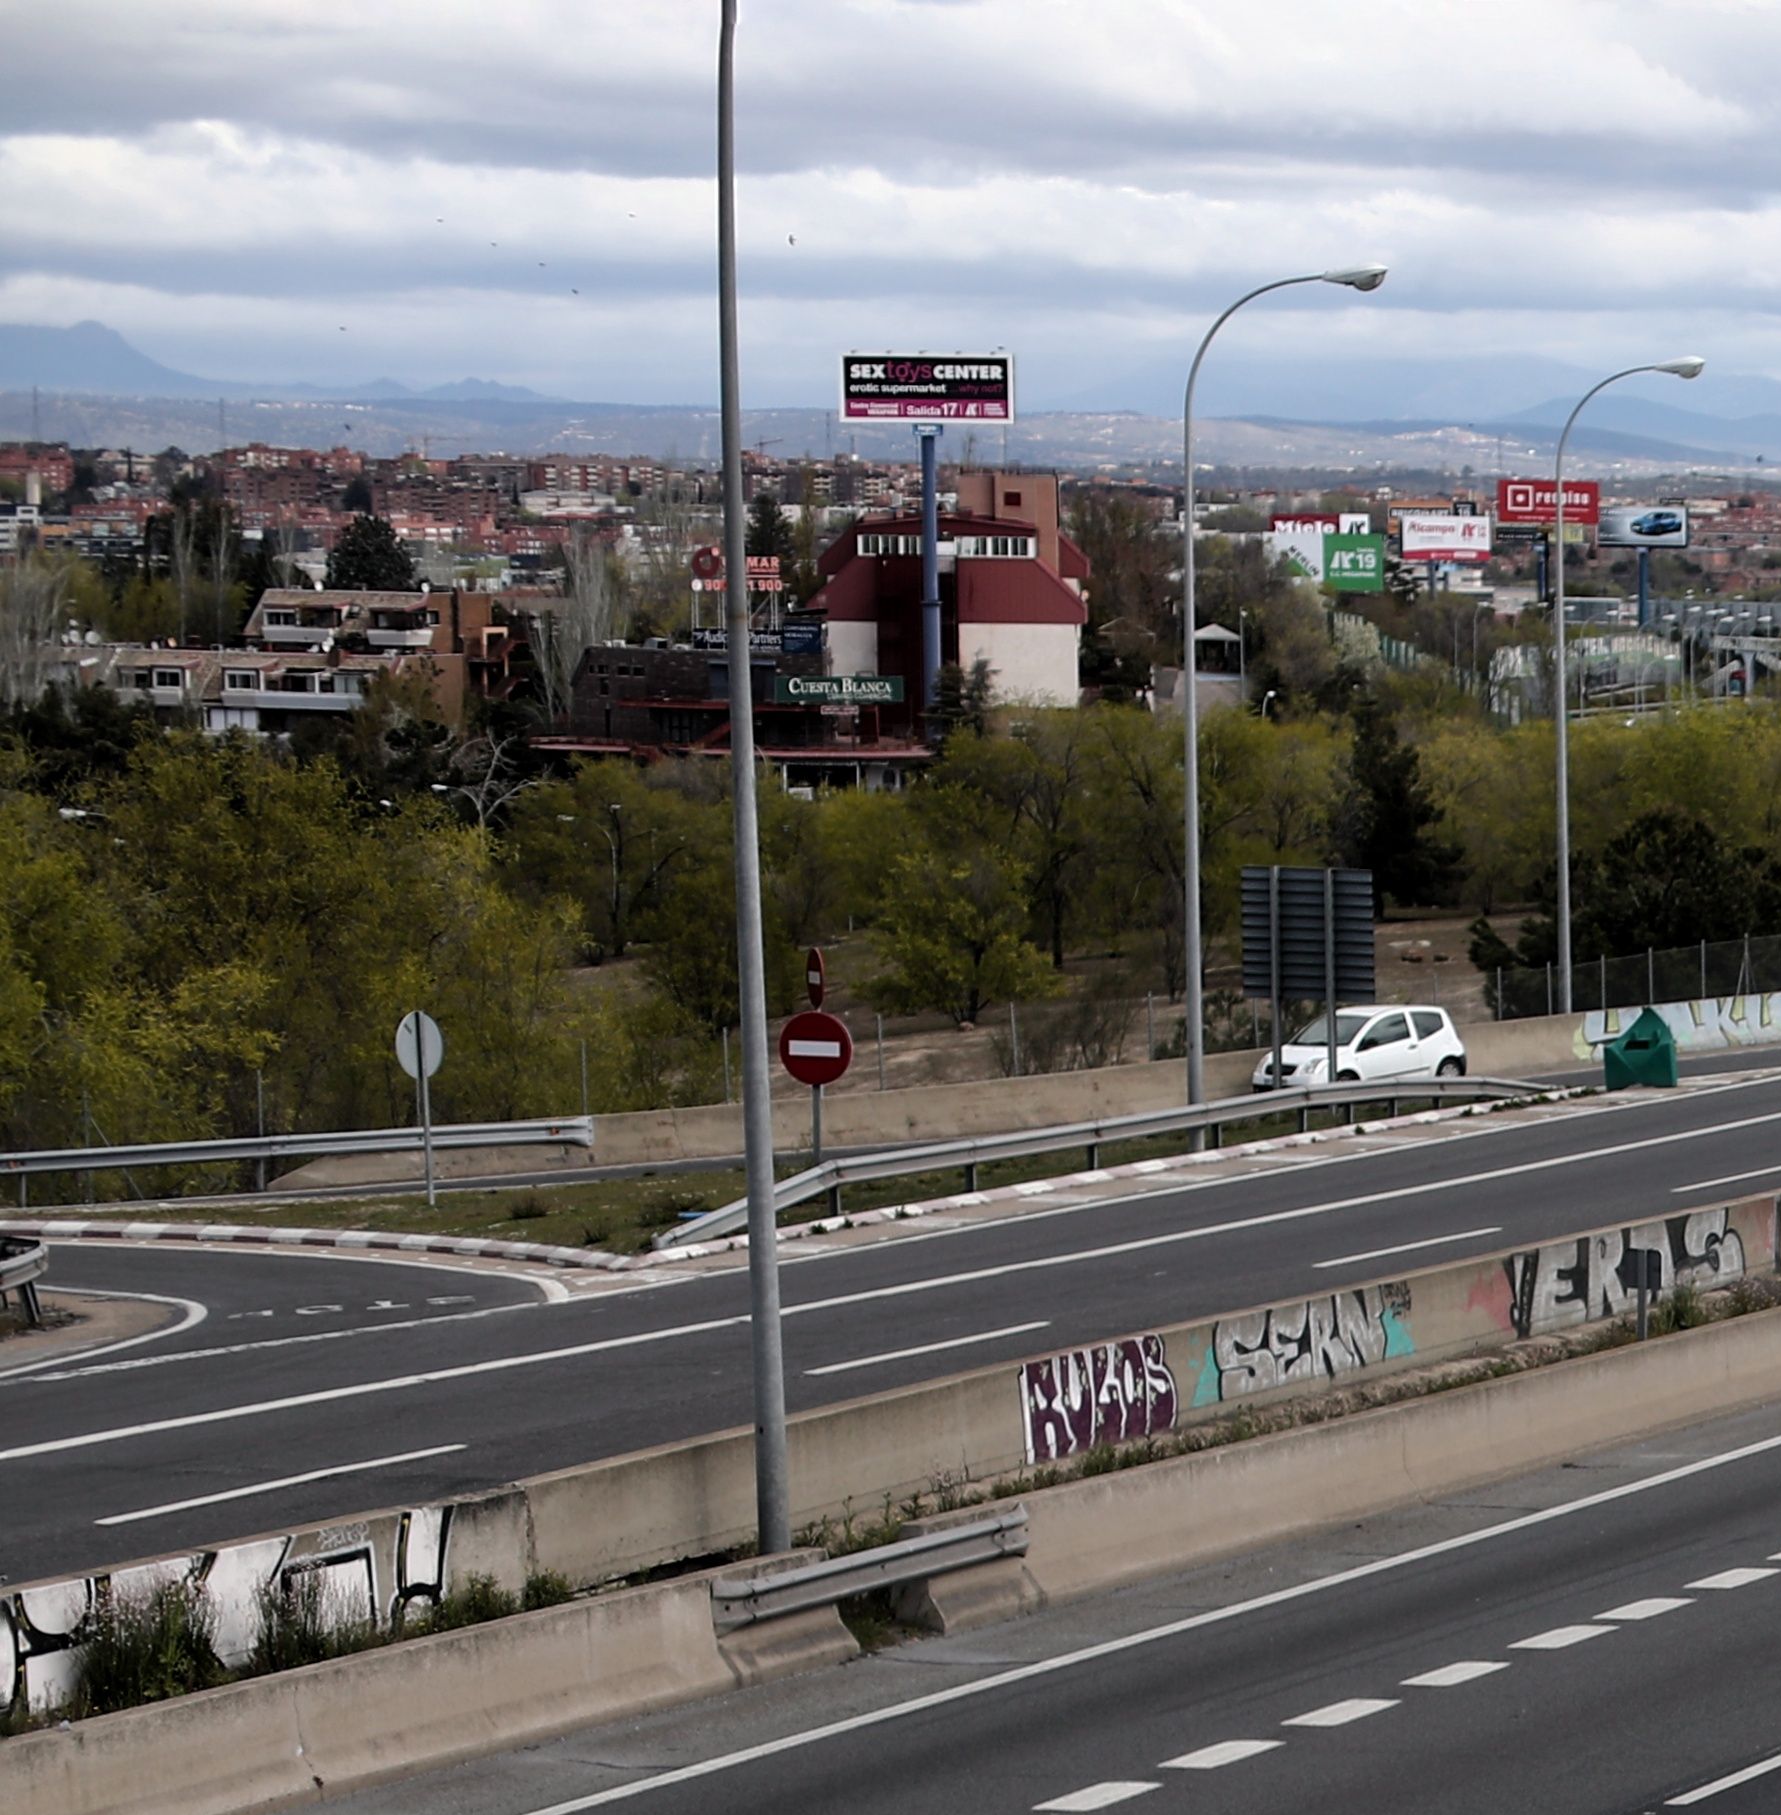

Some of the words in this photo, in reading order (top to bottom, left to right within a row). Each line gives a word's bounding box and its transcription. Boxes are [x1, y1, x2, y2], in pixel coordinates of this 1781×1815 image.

[850, 364, 885, 379] SEX
[886, 361, 932, 382] toys
[933, 365, 1003, 380] CENTER
[850, 384, 879, 393] erotic
[881, 384, 946, 394] supermarket
[907, 405, 941, 416] Salida
[942, 403, 957, 415] 17
[1274, 520, 1335, 534] Miele
[1356, 554, 1376, 569] 19
